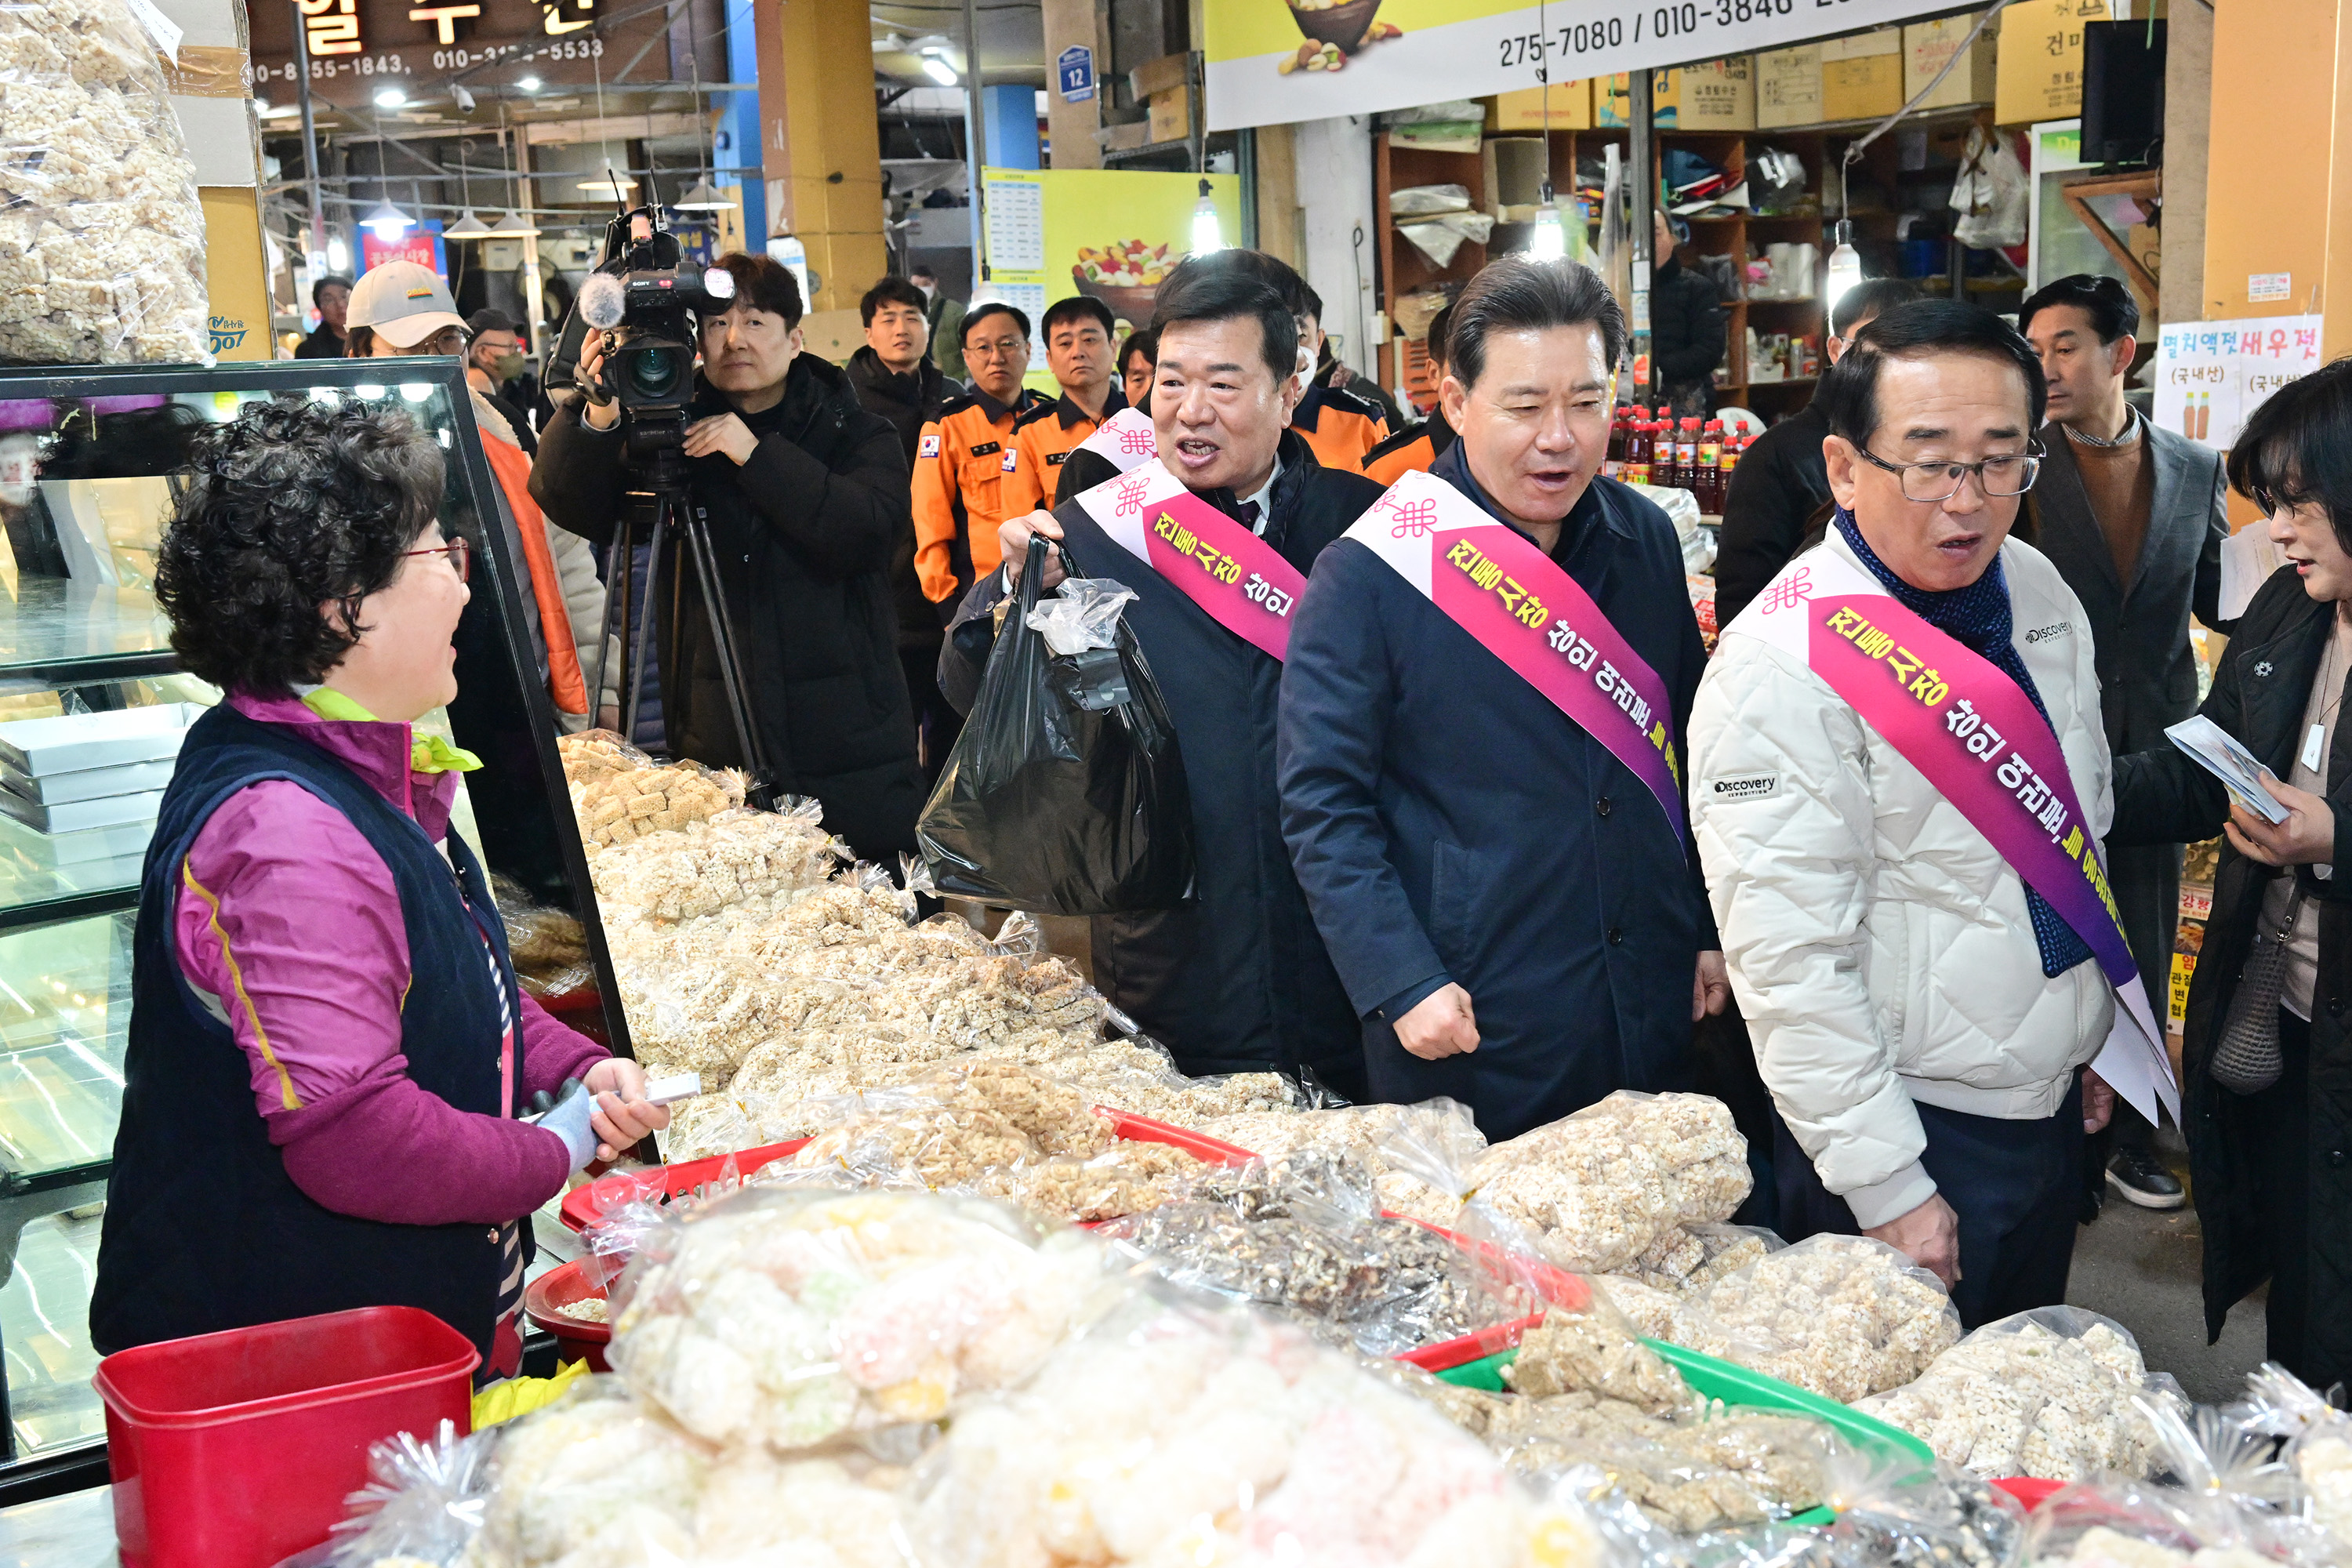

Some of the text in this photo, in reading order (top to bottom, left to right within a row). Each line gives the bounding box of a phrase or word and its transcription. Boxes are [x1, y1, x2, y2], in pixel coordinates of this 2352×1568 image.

[1501, 18, 1623, 67] 275-7080
[1633, 13, 1642, 43] /
[1069, 67, 1083, 87] 12
[2163, 331, 2237, 359] 멸치액젓
[2240, 328, 2317, 360] 새우젓
[2172, 366, 2224, 384] (국내산)
[1154, 511, 1294, 617] 전통시장 상인
[1446, 539, 1666, 750] 전통시장 상인 여러분, 늘
[1826, 606, 1949, 707] 전통시장
[1946, 699, 2007, 762] 상인
[1996, 753, 2069, 844] 여러분,
[2061, 824, 2084, 860] 늘
[2182, 955, 2195, 971] 암
[2171, 1003, 2187, 1017] 협
